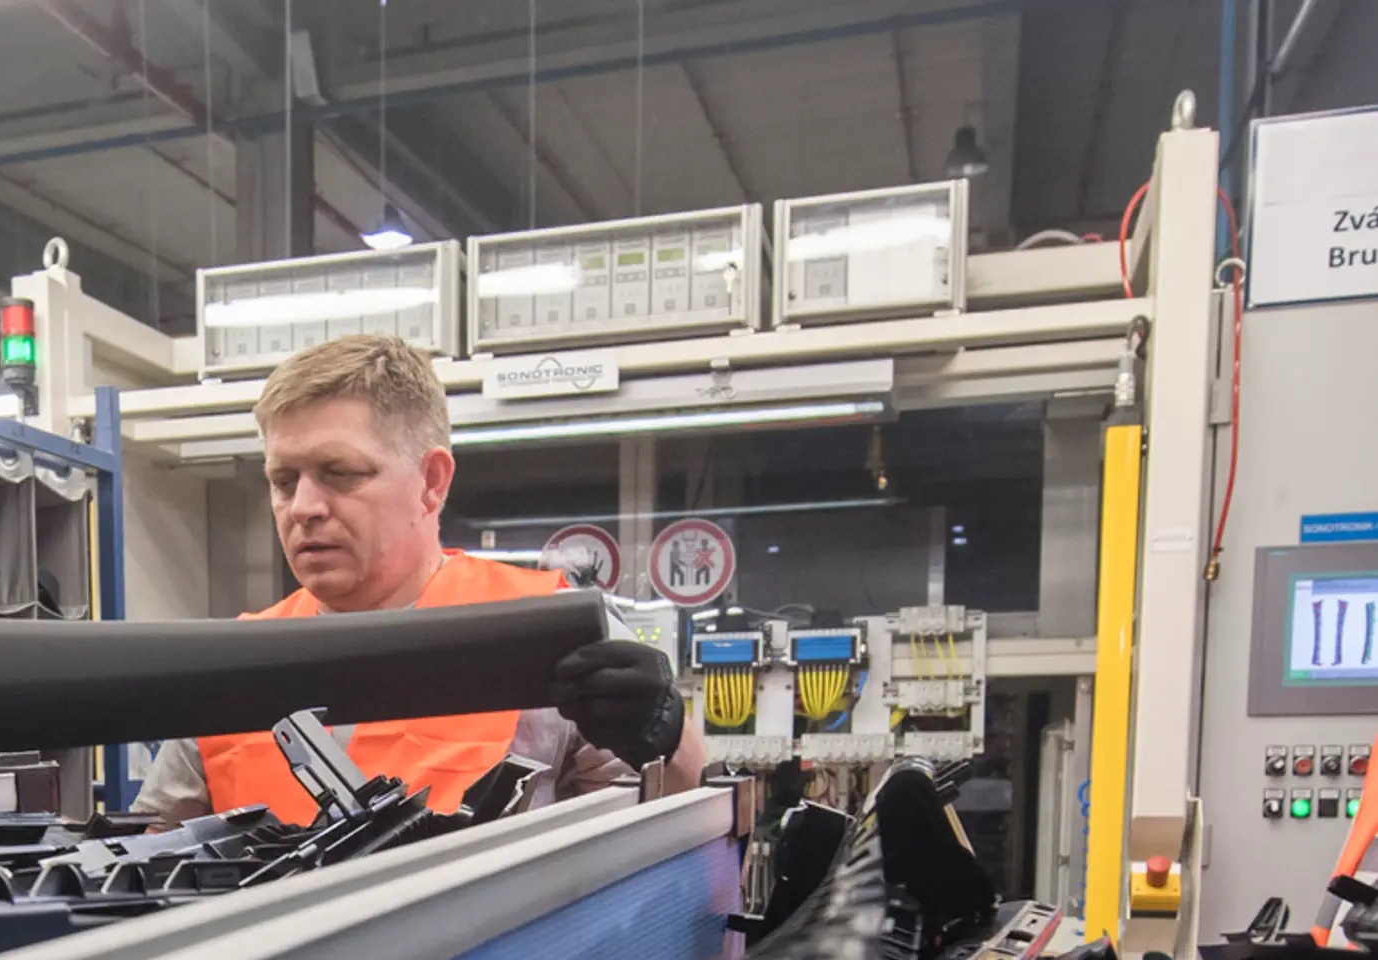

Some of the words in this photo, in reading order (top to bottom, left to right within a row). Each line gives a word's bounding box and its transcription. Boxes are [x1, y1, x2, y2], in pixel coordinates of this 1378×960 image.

[1333, 204, 1378, 232] Zvá
[1329, 246, 1377, 268] Bru
[497, 364, 603, 382] SONOTRONIC
